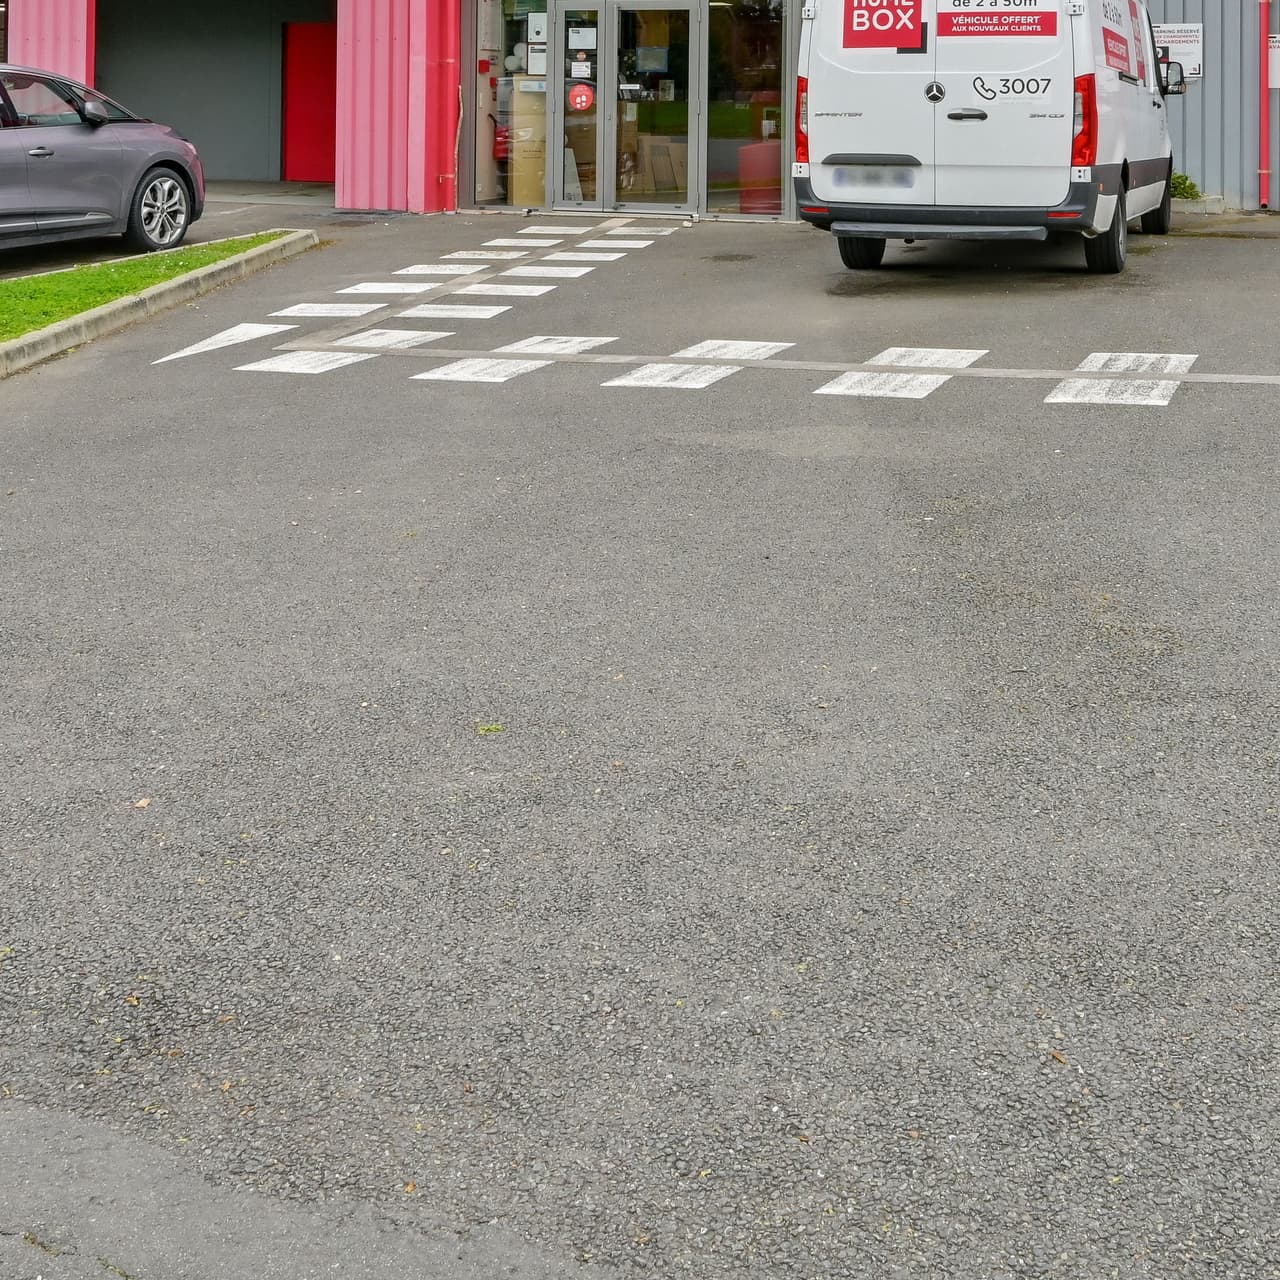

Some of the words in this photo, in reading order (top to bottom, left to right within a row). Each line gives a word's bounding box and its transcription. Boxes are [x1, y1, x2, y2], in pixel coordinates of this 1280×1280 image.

[852, 8, 915, 31] BOX
[952, 14, 999, 24] VÉHICULE
[1010, 24, 1042, 32] CLIENTS
[999, 78, 1052, 94] 3007
